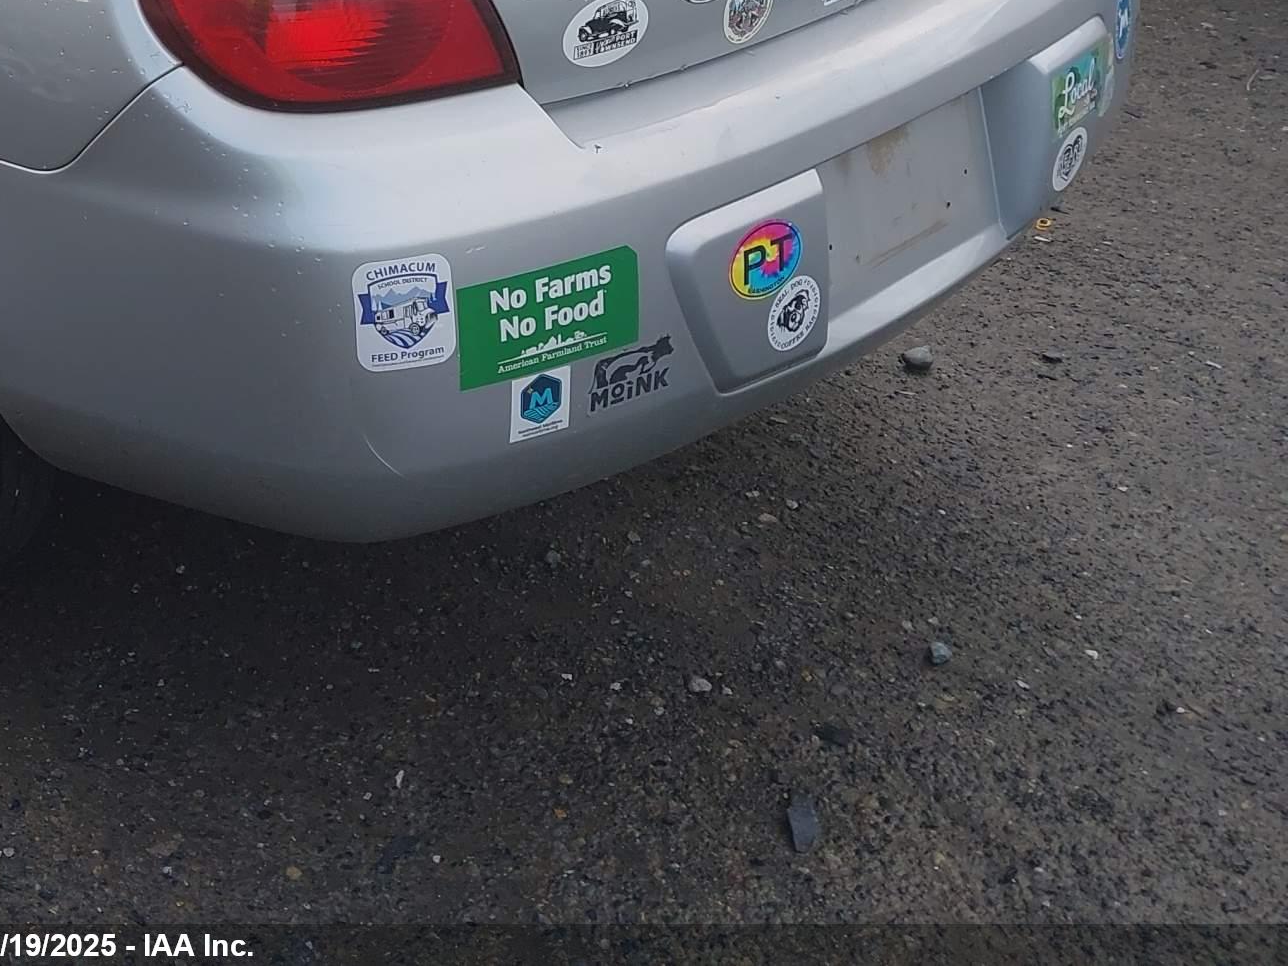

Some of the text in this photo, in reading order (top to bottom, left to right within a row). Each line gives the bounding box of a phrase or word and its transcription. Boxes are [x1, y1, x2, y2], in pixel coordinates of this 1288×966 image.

[1058, 57, 1096, 118] Local
[366, 262, 436, 281] CHIMACUM
[743, 232, 793, 286] PT
[378, 277, 428, 290] SCHOOL DISTRICT
[489, 264, 612, 314] No Farms
[499, 289, 606, 343] No Food
[371, 353, 399, 363] FEED
[400, 346, 445, 360] Program
[497, 336, 608, 374] American Farmland Trust
[530, 387, 554, 410] M
